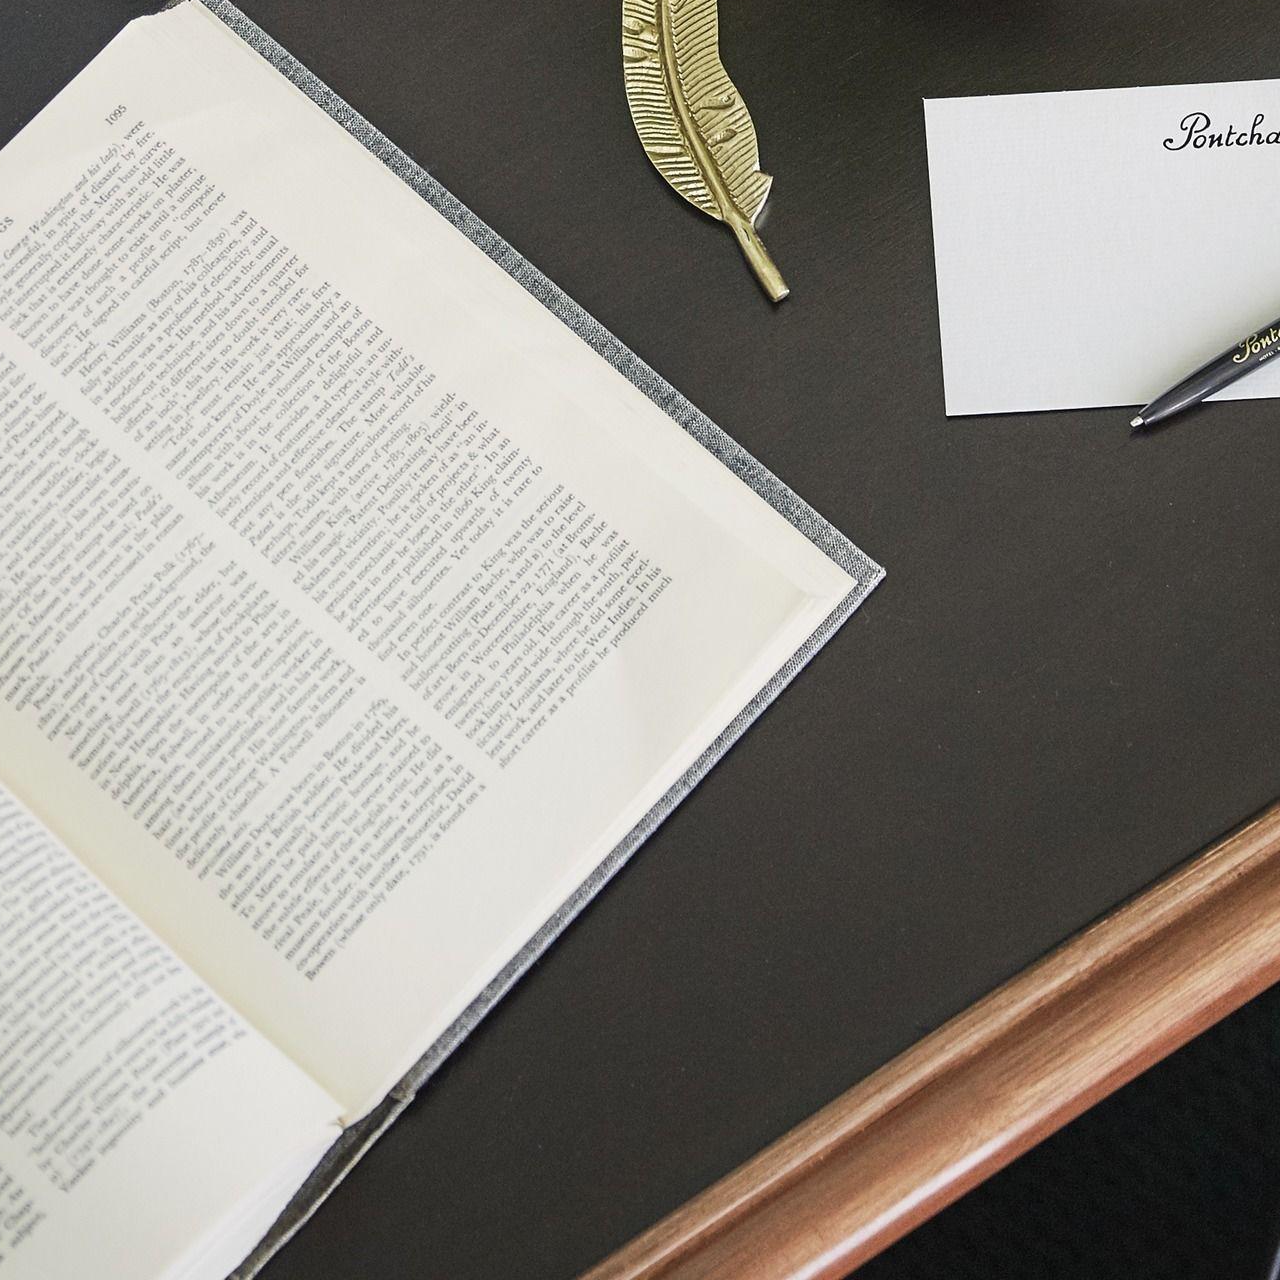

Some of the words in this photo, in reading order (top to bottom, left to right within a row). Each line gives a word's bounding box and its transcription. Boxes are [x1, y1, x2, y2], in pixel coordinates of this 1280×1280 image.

[105, 104, 127, 126] 1095
[117, 163, 139, 183] bust
[151, 174, 168, 188] He
[168, 157, 185, 172] was
[183, 216, 202, 232] but
[202, 192, 225, 216] never
[230, 209, 247, 226] was
[180, 280, 197, 295] his
[240, 217, 257, 236] and
[223, 275, 241, 291] was
[240, 260, 256, 274] the
[255, 235, 278, 259] usual
[213, 306, 230, 320] his
[229, 245, 289, 307] advertisements
[322, 310, 339, 330] and
[338, 300, 351, 313] an
[430, 392, 455, 418] wield-
[470, 474, 496, 498] King
[494, 448, 519, 474] claim-
[504, 530, 521, 547] was
[520, 514, 536, 529] the
[535, 484, 564, 514] serious
[526, 526, 544, 543] was
[543, 515, 554, 526] to
[554, 493, 575, 515] raise
[582, 553, 597, 566] he
[601, 530, 618, 547] was
[595, 646, 609, 659] he
[609, 601, 648, 647] produced
[647, 576, 672, 602] much
